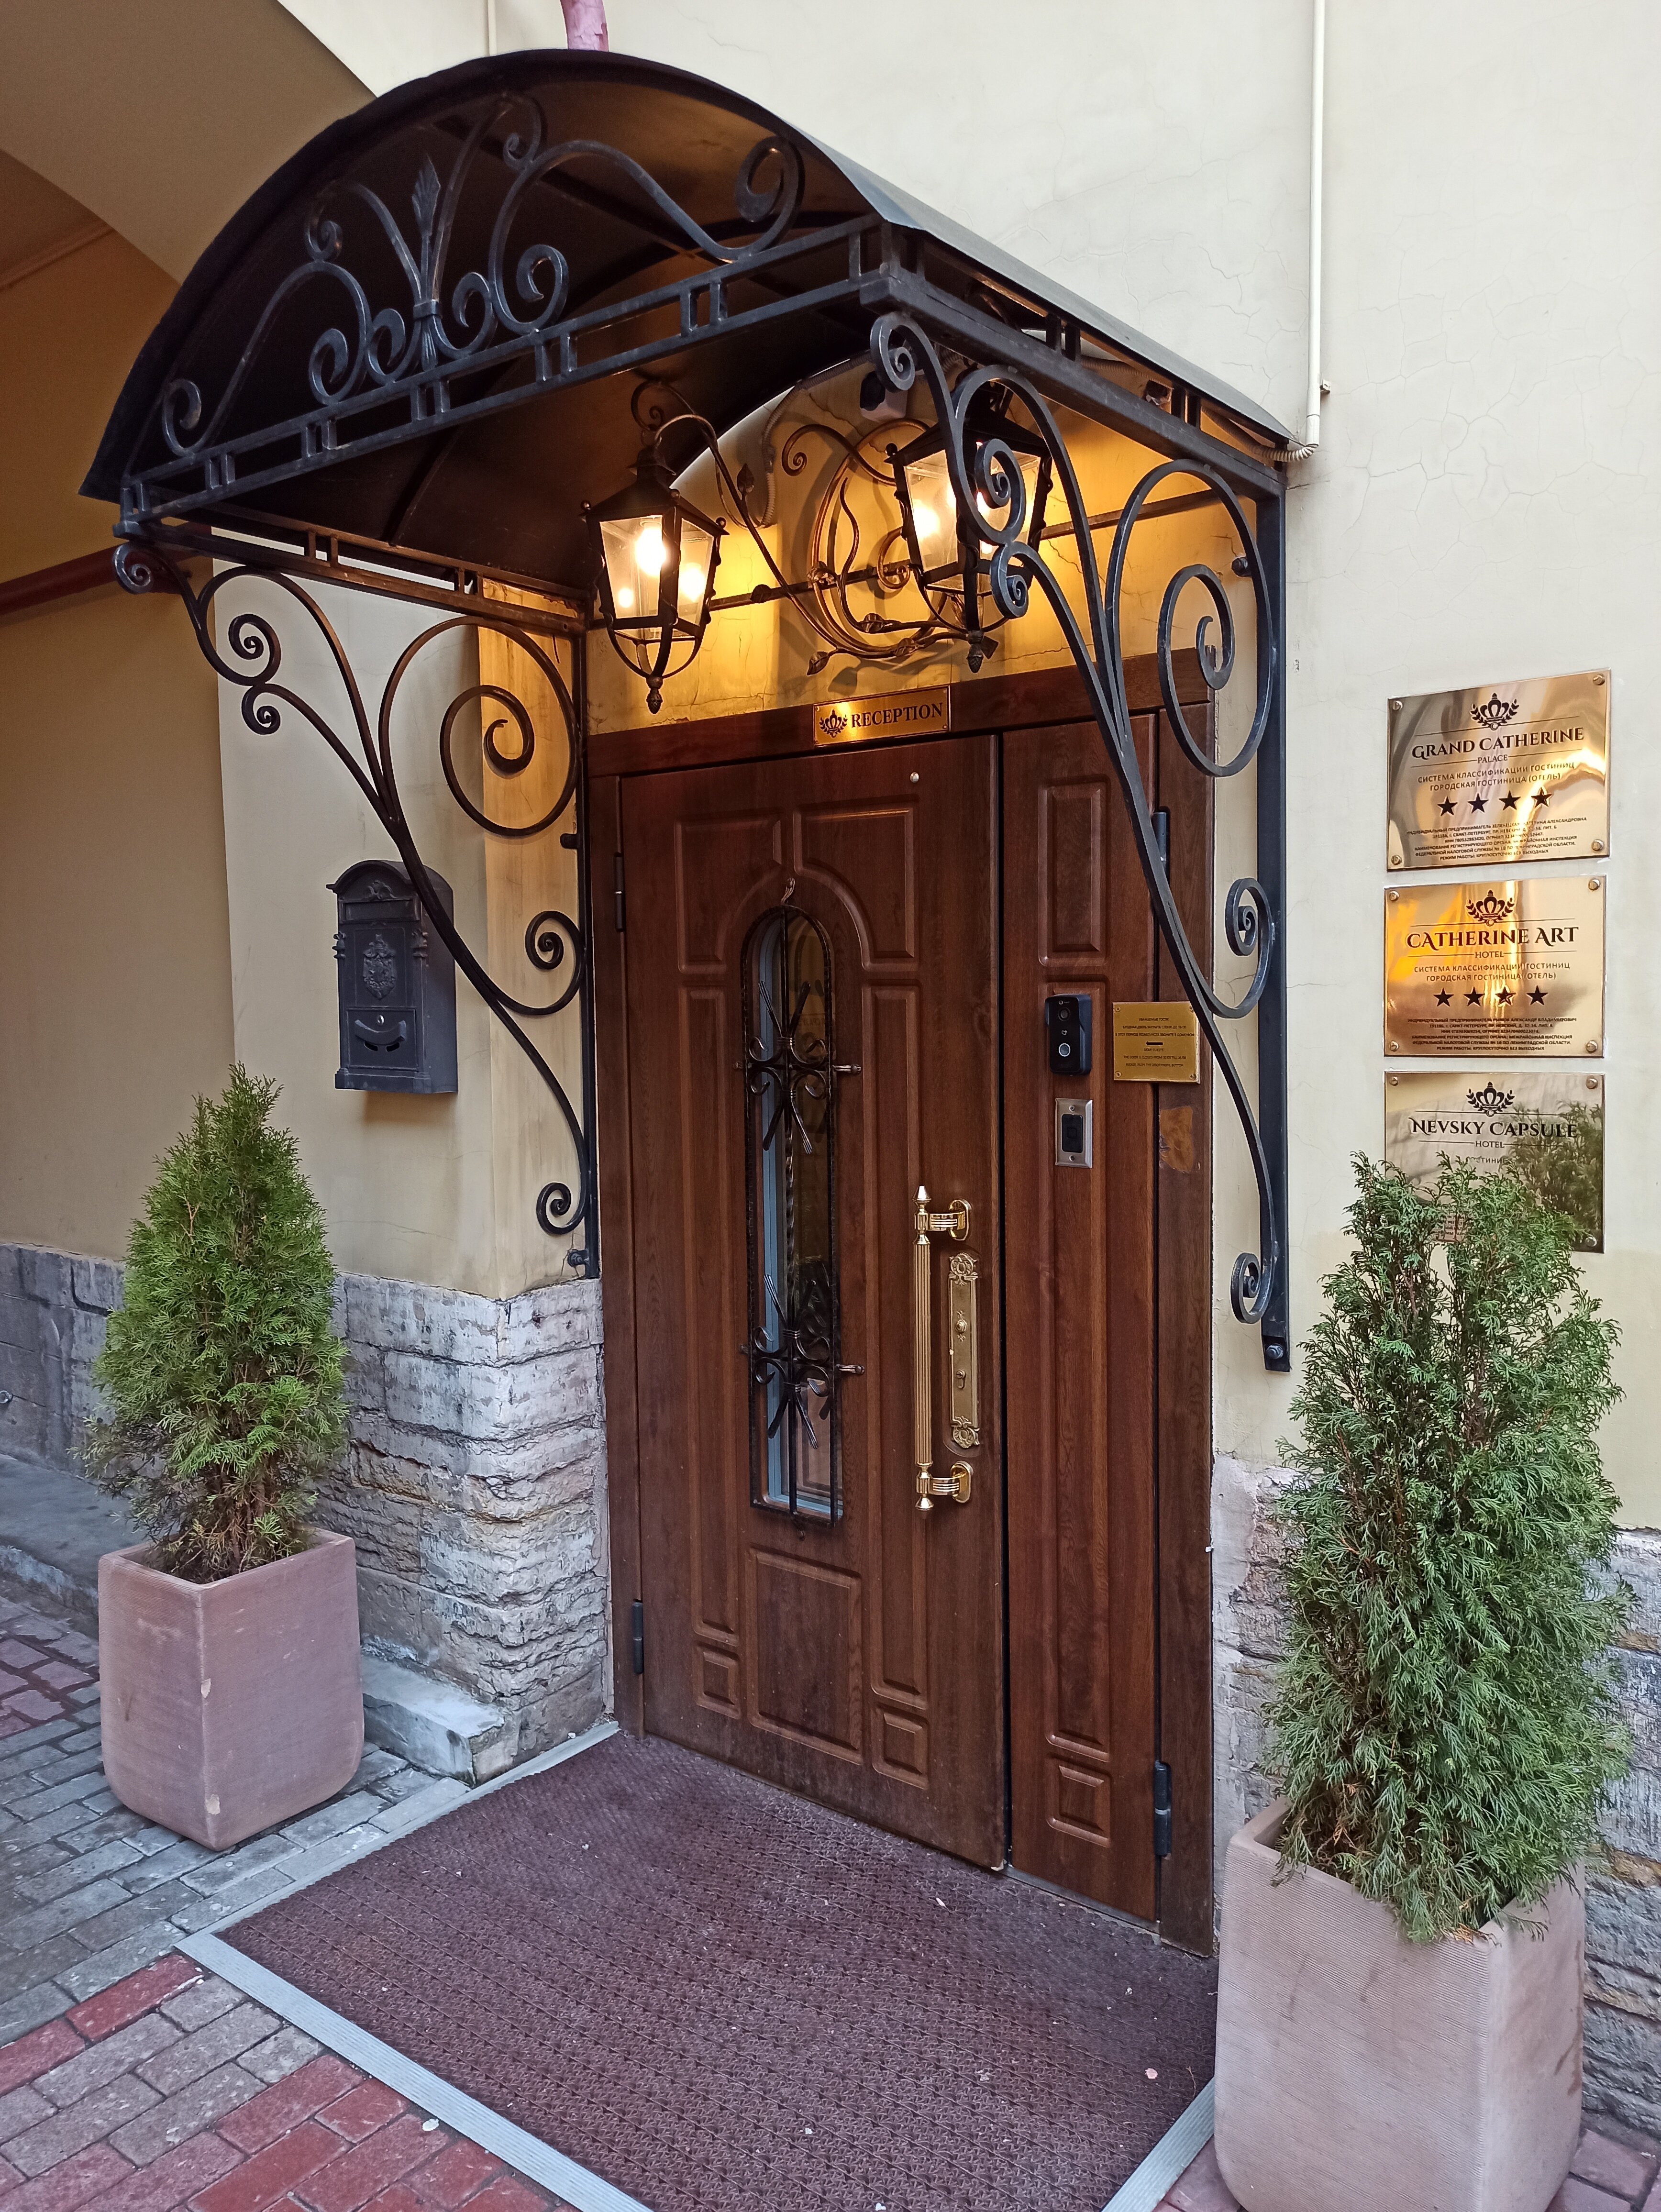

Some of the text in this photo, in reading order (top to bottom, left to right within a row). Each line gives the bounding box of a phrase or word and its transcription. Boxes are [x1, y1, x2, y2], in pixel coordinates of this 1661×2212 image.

[851, 702, 942, 728] RECEPTION
[1412, 727, 1584, 760] GRAND CATHERINE
[1477, 754, 1508, 763] PALACE
[1418, 762, 1574, 783] СИСТЕМА КЛАССИФИКАЦИИ ГОСТИНИЦ
[1430, 773, 1561, 791] ГОРОДСКАЯ ГОСТИНИЦА (ОТЕЛЬ)
[1407, 927, 1579, 951] CATHERINE ART
[1452, 963, 1523, 972] КЛАССИФИКАЦИИ
[1408, 1117, 1578, 1138] NEVSKY CAPSULE
